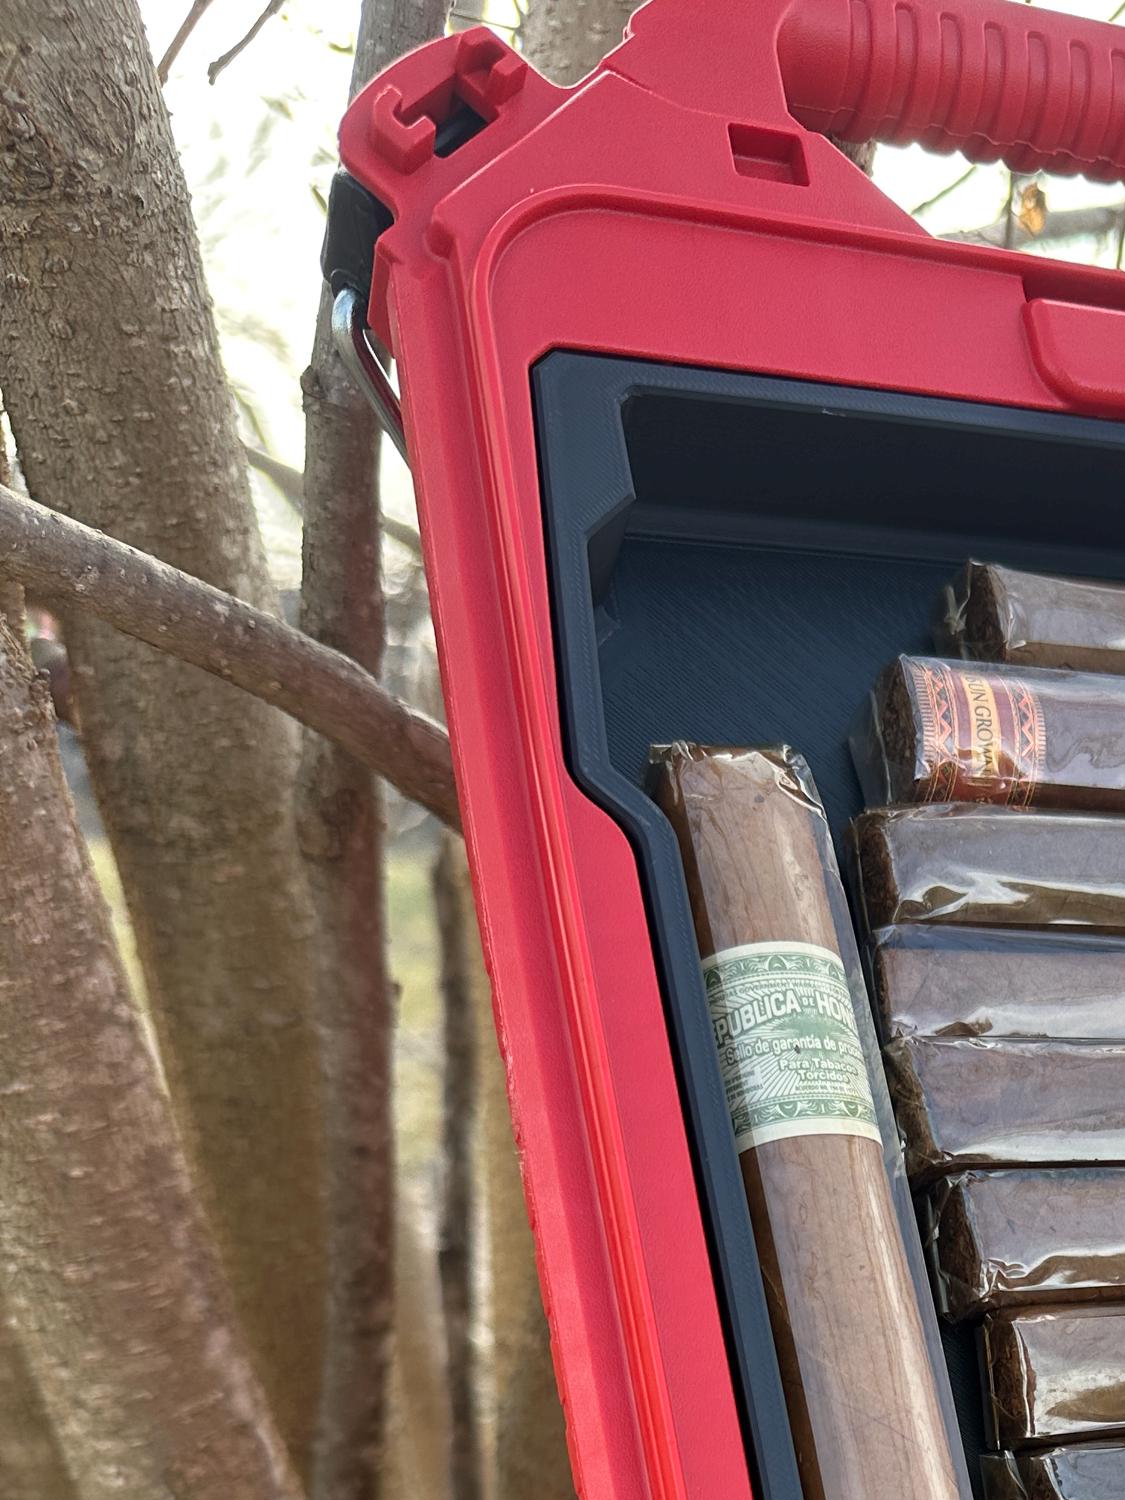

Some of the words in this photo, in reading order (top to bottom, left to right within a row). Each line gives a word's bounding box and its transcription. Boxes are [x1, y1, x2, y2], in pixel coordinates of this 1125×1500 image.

[713, 989, 802, 1046] PUBLICA
[802, 996, 816, 1008] DE
[726, 1042, 753, 1067] Sello
[754, 1038, 771, 1056] de
[773, 1034, 823, 1056] garantía
[824, 1036, 838, 1051] de
[779, 1059, 810, 1072] Para
[812, 1057, 859, 1077] Tabacos
[800, 1070, 849, 1084] Torcidos
